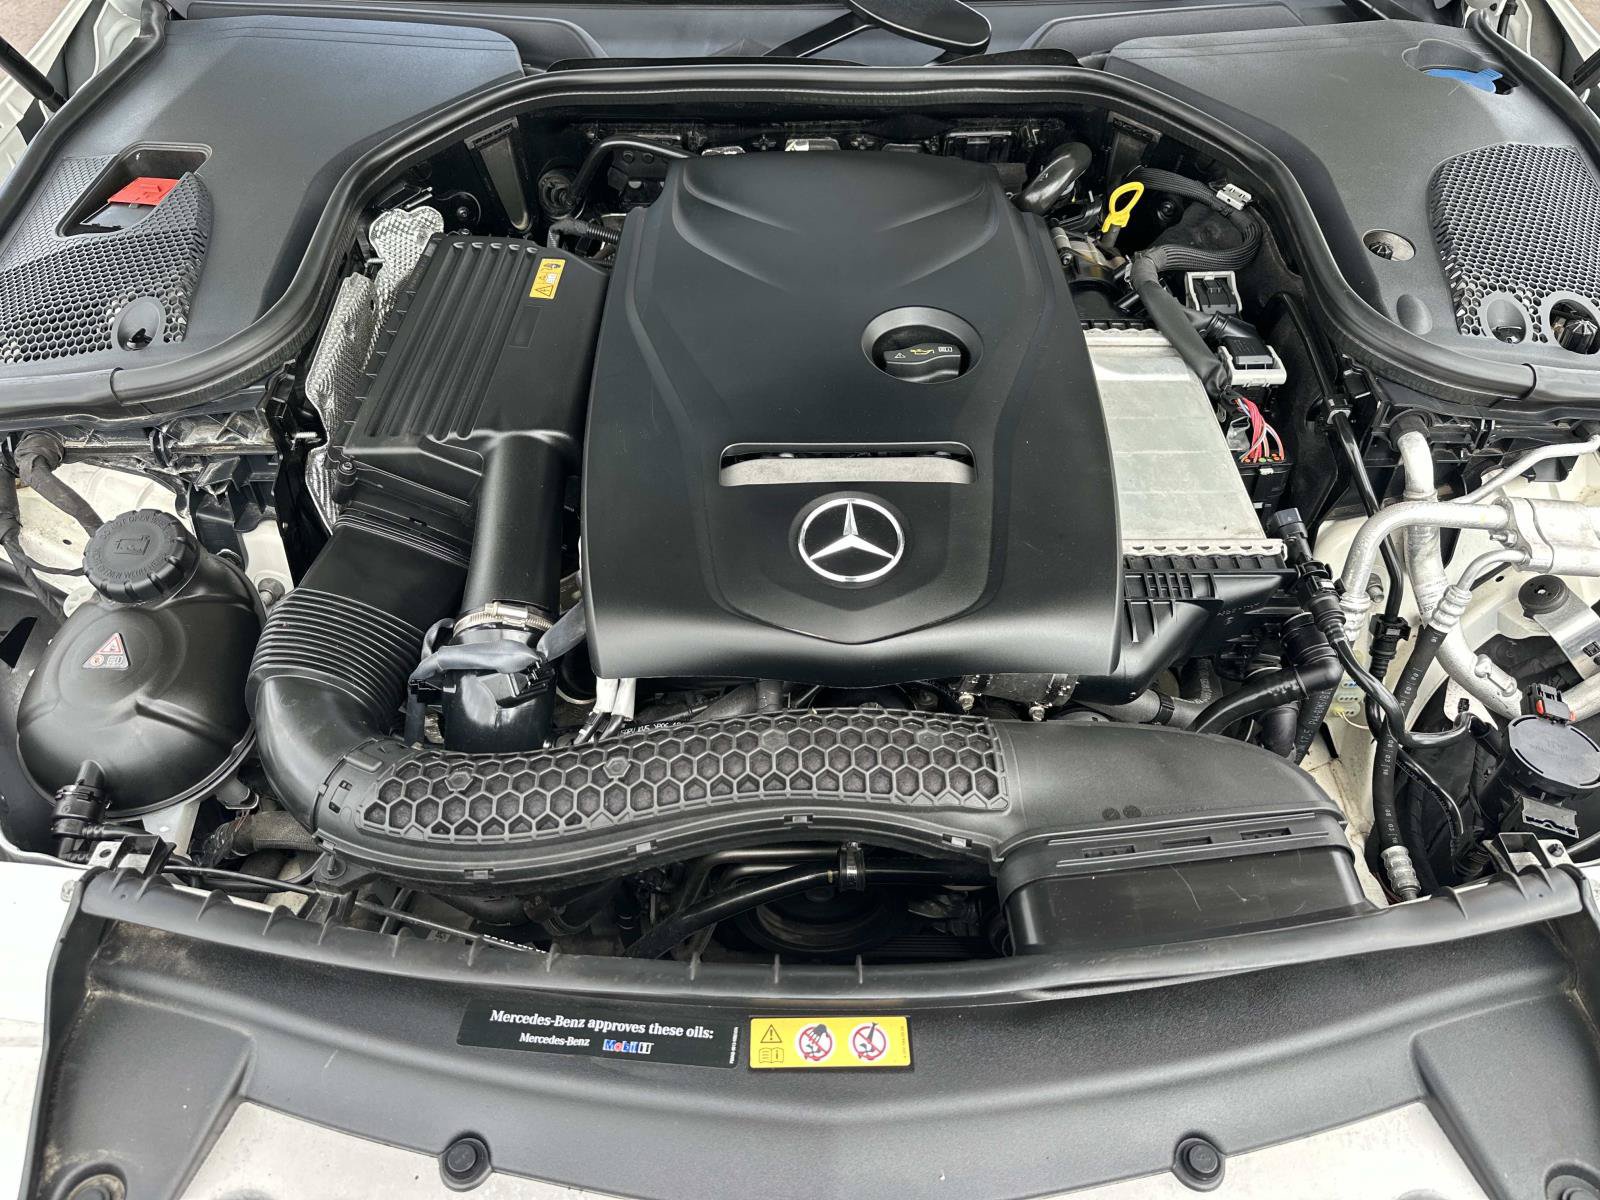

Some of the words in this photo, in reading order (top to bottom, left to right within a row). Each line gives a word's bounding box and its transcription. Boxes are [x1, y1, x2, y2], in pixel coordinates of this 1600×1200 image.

[489, 1009, 586, 1028] Mercedes-Benz
[587, 1018, 646, 1034] approves
[648, 1022, 684, 1037] these
[685, 1025, 714, 1039] oils:
[519, 1032, 591, 1047] Mercedes-Benz
[602, 1038, 639, 1053] Mobil
